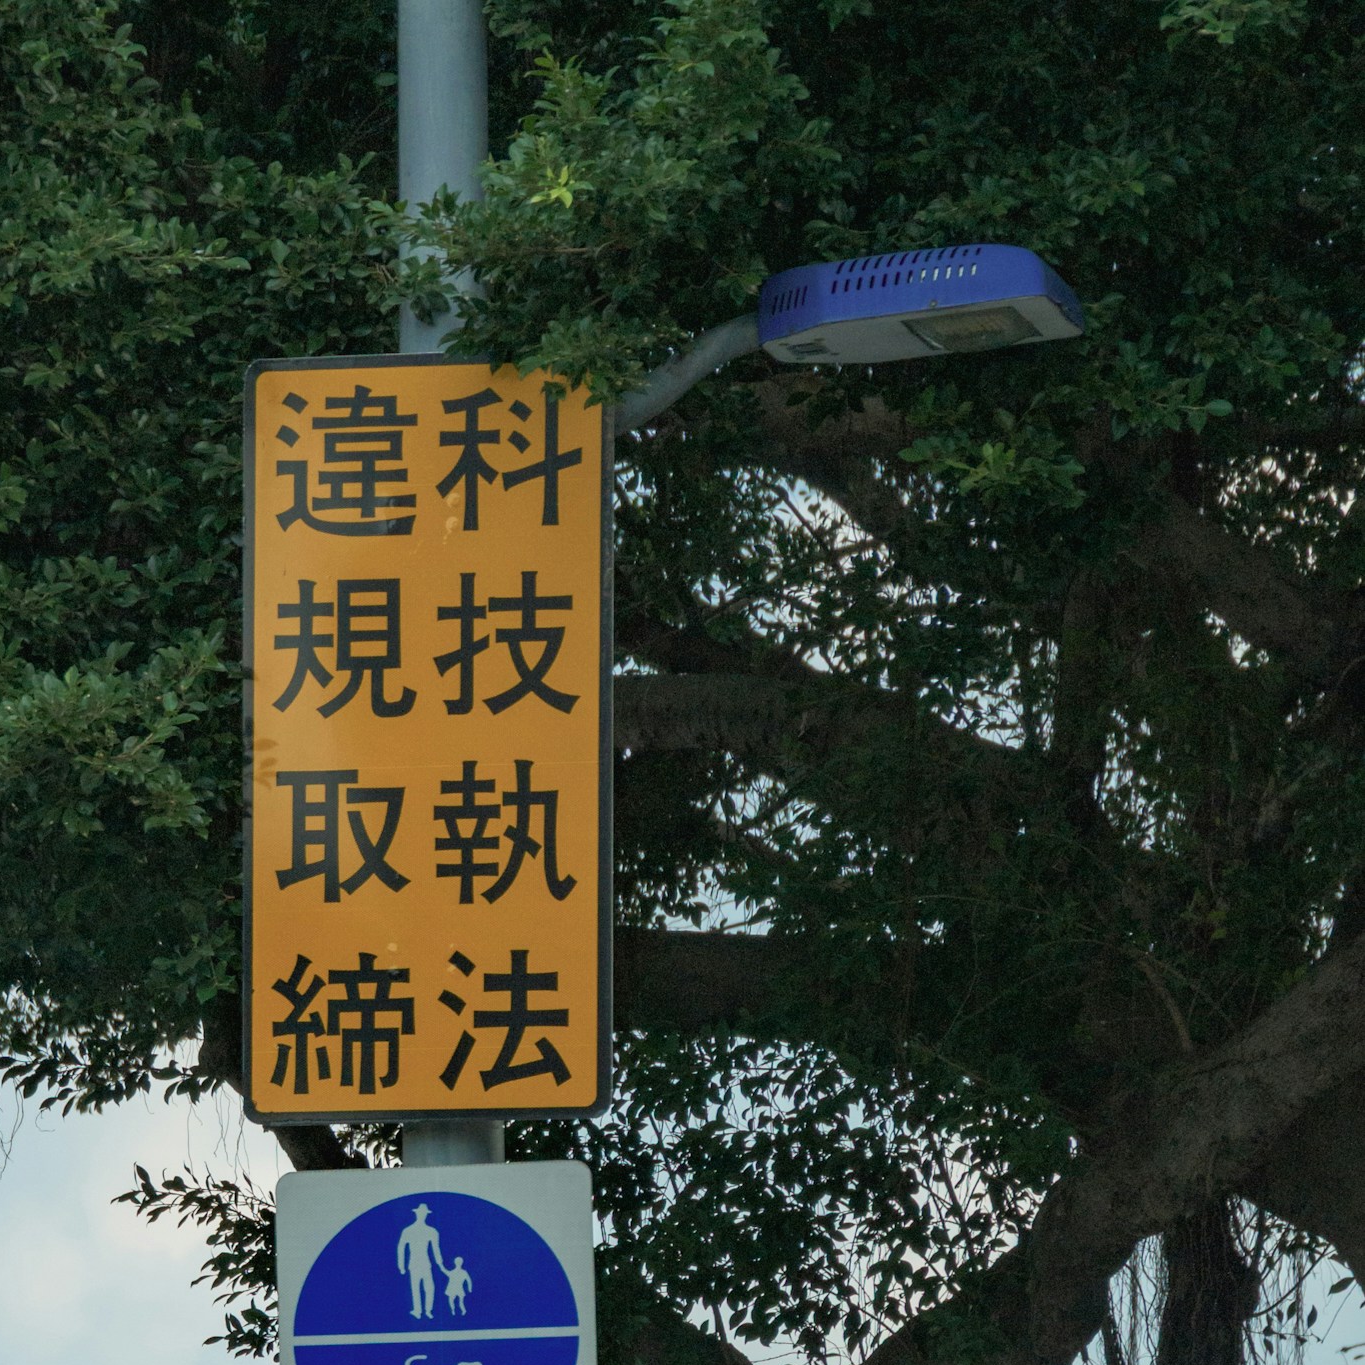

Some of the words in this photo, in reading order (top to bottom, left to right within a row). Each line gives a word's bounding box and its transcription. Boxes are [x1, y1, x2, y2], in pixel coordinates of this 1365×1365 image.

[270, 384, 419, 1096] 違規取締
[434, 386, 583, 1091] 科技執法
